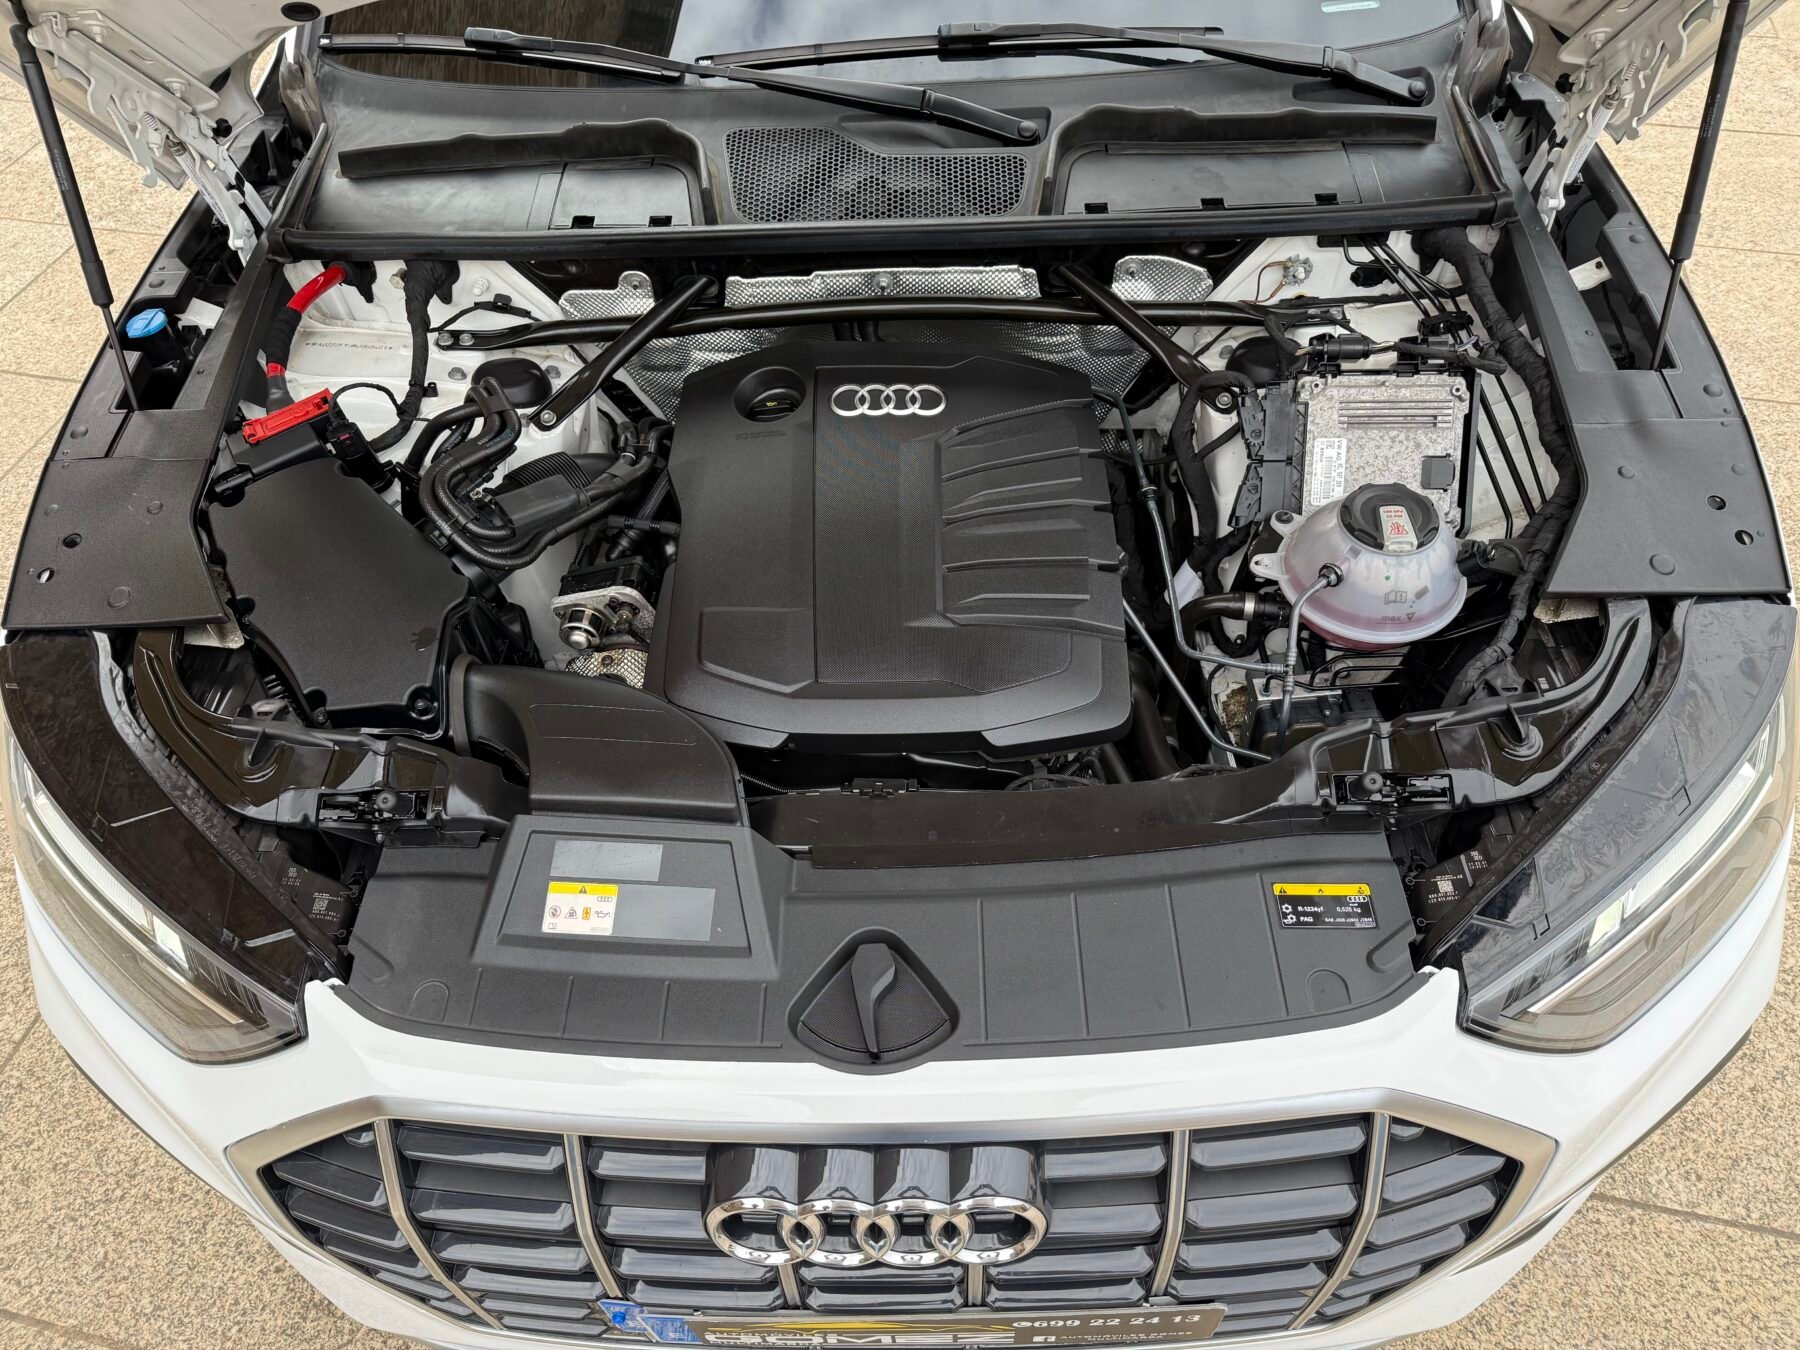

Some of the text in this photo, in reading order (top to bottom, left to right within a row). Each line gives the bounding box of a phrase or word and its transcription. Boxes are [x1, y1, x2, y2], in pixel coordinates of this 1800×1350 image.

[1381, 615, 1402, 623] max
[1033, 1314, 1201, 1328] 699 22 24 13
